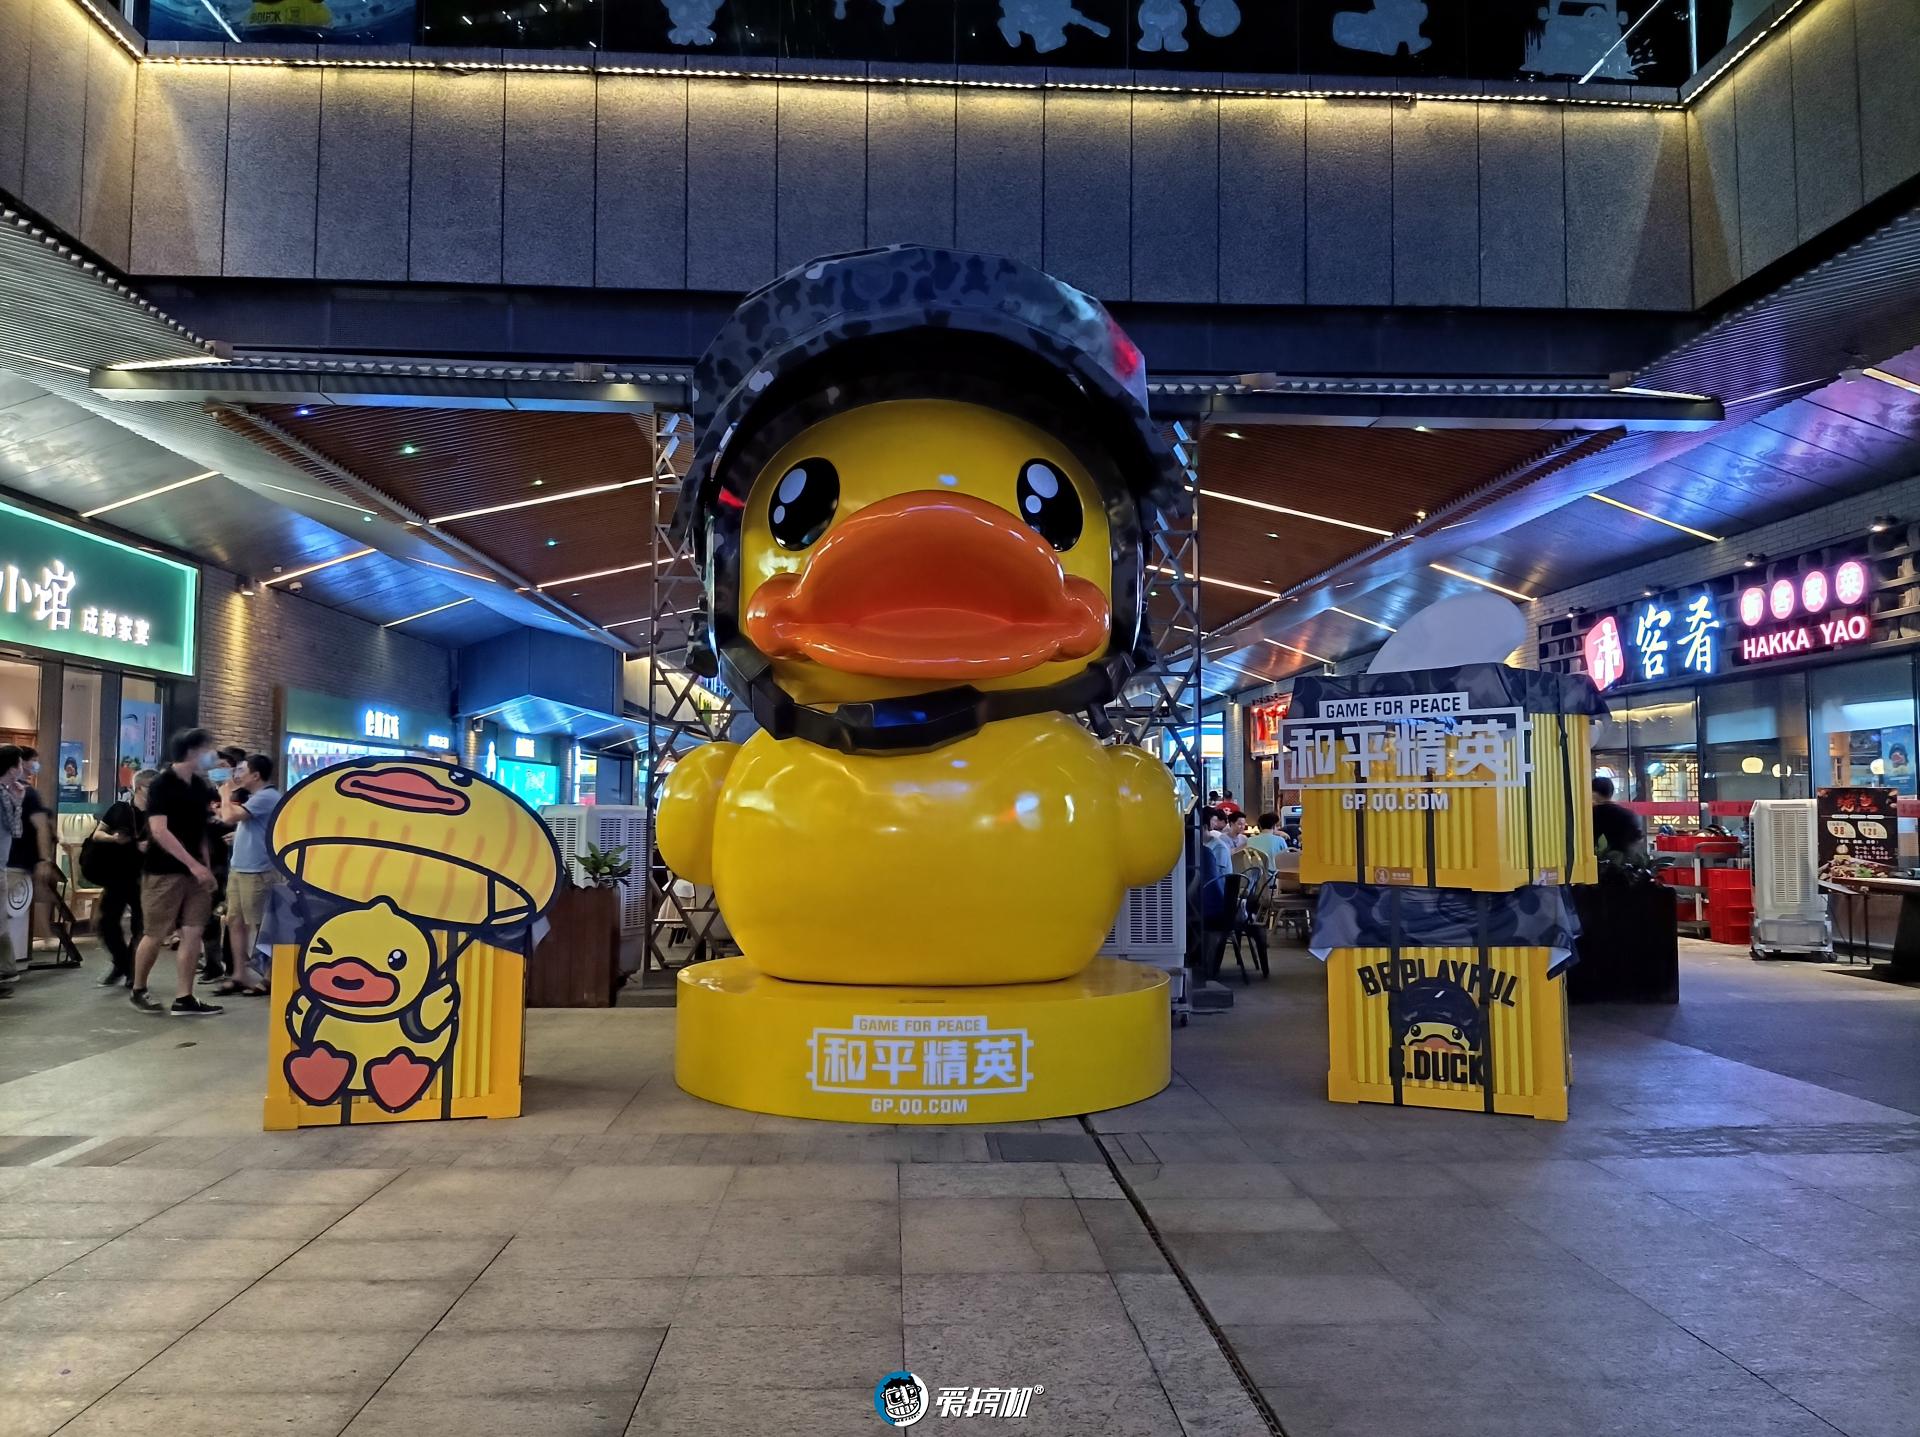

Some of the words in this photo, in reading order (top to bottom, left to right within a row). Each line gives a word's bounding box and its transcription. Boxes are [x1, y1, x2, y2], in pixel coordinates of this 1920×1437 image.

[1636, 595, 1720, 679] 客肴
[1743, 628, 1811, 659] HAKKA
[1820, 616, 1866, 645] YAO
[1326, 702, 1368, 719] GAME
[1374, 700, 1404, 716] FOR
[1410, 697, 1462, 713] PEACE
[1290, 719, 1508, 779] 和平精英
[1342, 793, 1449, 811] GP.QQ.COM
[859, 1018, 899, 1032] GAME
[904, 1019, 931, 1032] FOR
[937, 1019, 981, 1032] PEACE
[823, 1037, 1016, 1086] 和平精英
[1389, 1048, 1485, 1085] .DUCK
[871, 1098, 968, 1114] GP.QQ.COM
